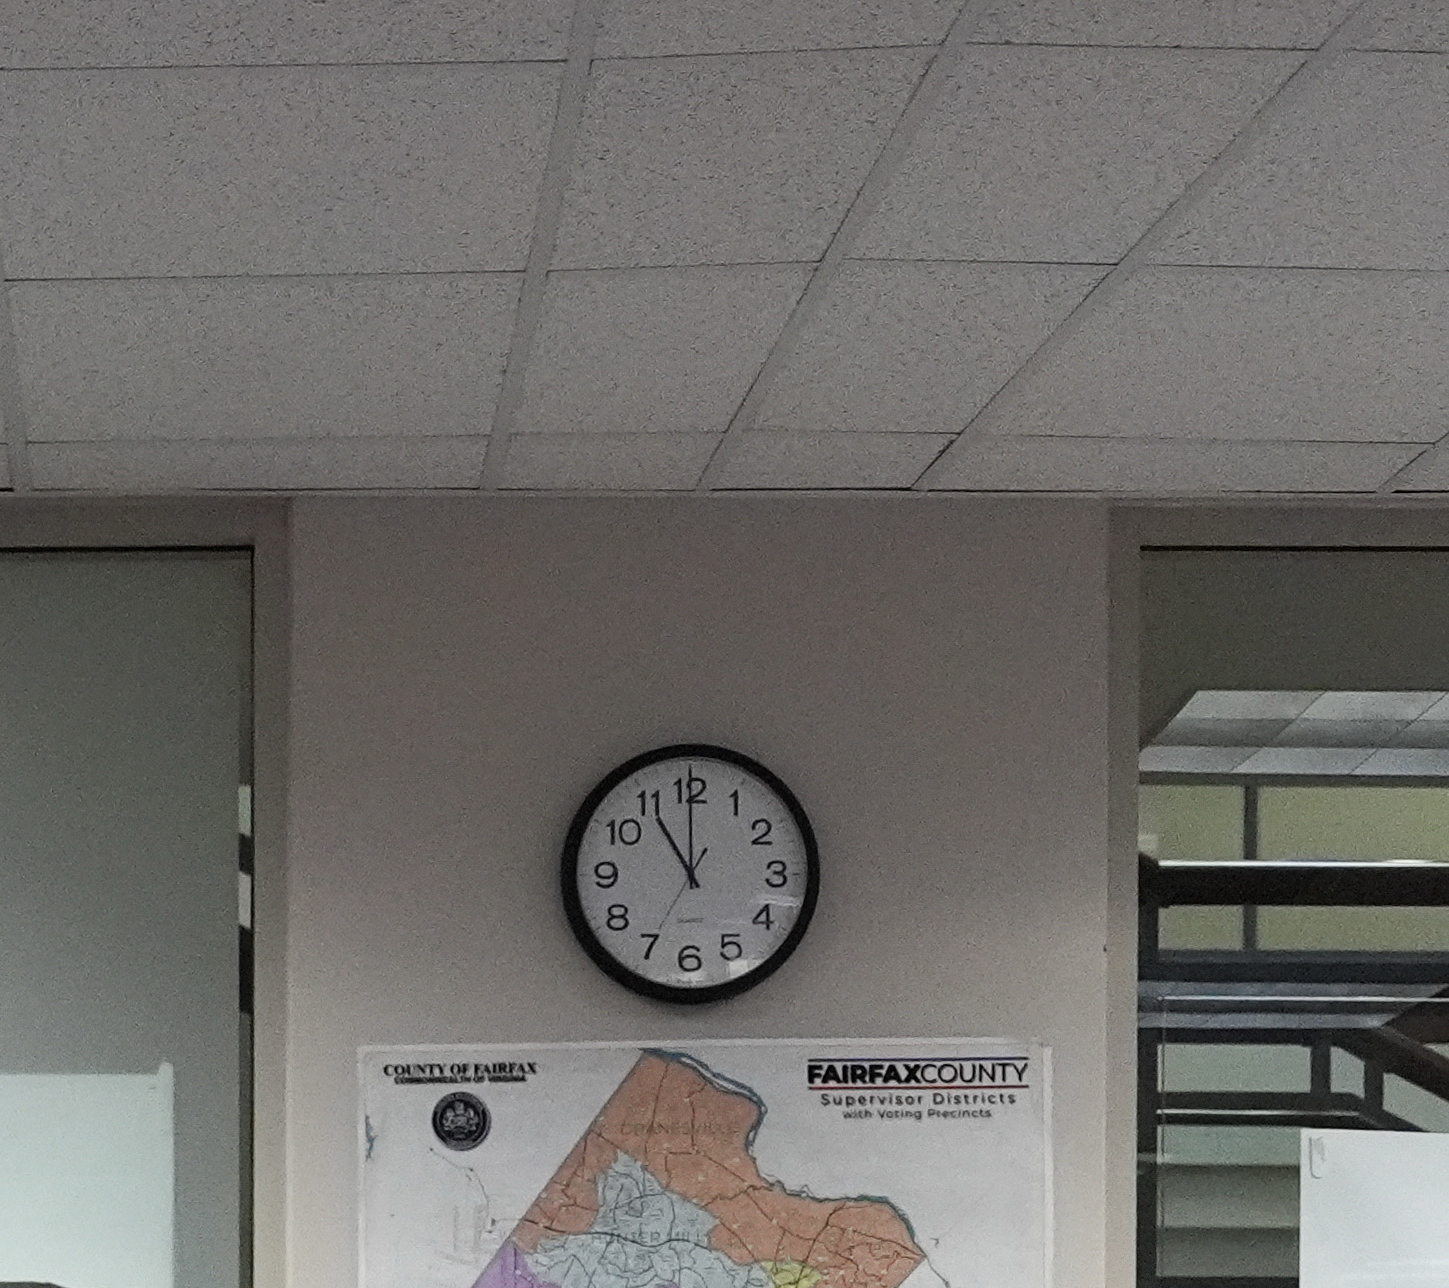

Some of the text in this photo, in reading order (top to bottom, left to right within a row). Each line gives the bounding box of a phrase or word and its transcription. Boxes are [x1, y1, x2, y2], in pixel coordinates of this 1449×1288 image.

[637, 789, 660, 816] 11
[673, 777, 708, 804] 12
[729, 789, 739, 816] 1
[606, 818, 642, 846] 10
[751, 818, 773, 846] 2
[594, 861, 619, 888] 9
[764, 860, 788, 888] 3
[606, 904, 630, 931] 8
[752, 903, 775, 930] 4
[640, 933, 660, 960] 7
[678, 945, 702, 972] 6
[719, 933, 743, 961] 5
[383, 1061, 537, 1077] COUNTY OF FAIRFAX
[820, 1092, 1017, 1107] Supervisor Districts
[878, 1109, 922, 1120] Voting
[927, 1108, 992, 1119] Precincts
